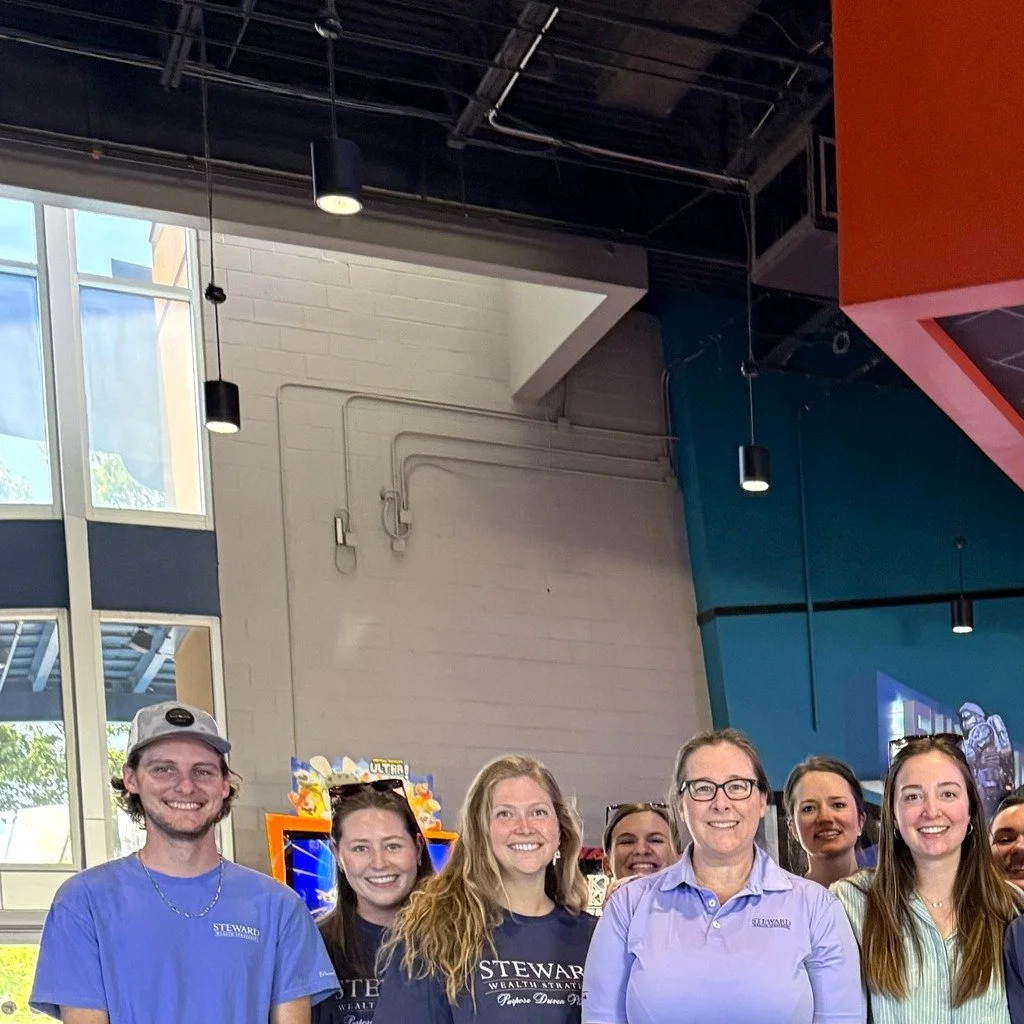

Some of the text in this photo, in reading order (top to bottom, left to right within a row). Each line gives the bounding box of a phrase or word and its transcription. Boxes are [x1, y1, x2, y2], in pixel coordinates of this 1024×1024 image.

[370, 761, 409, 780] ULTRA!
[213, 922, 260, 937] STEWARD
[479, 959, 584, 980] STEWAR
[488, 980, 537, 991] WEALTH
[338, 1001, 376, 1011] WEALT
[497, 992, 531, 1007] Purpose
[532, 992, 566, 1005] Driven
